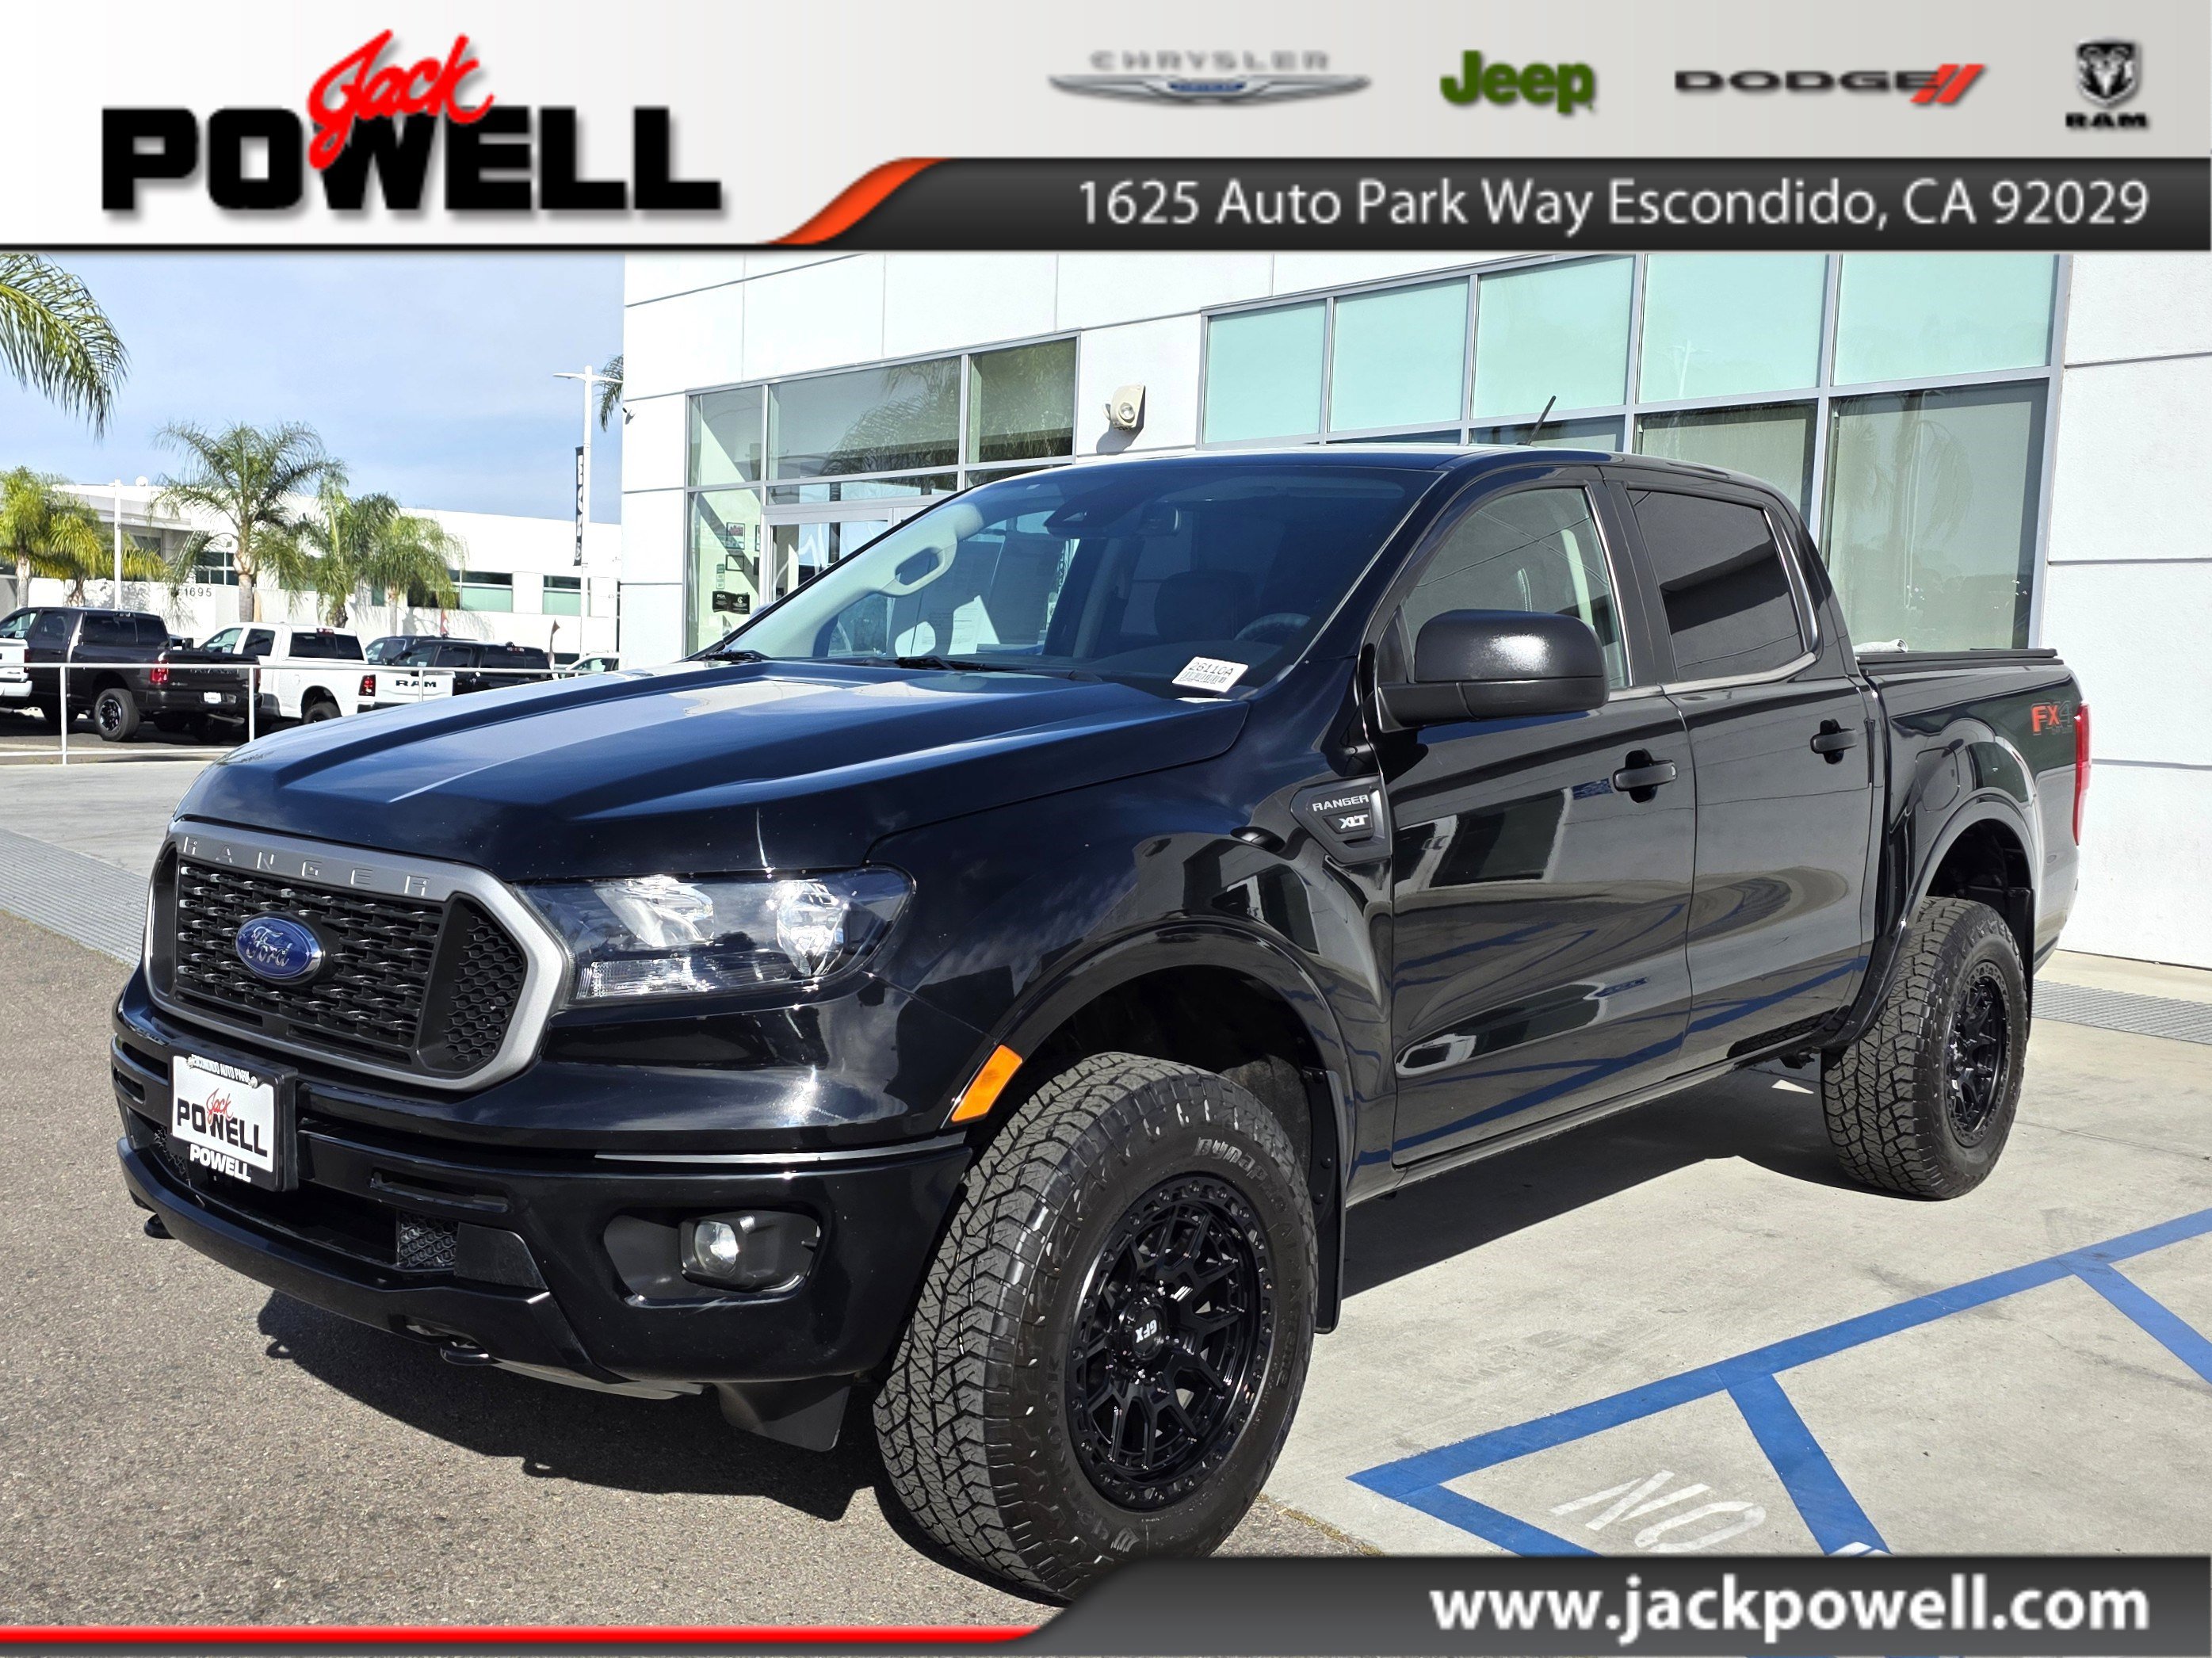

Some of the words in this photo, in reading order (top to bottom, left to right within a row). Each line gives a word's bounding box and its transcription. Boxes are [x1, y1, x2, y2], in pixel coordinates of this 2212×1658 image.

[185, 586, 212, 598] 1695
[395, 679, 437, 688] RAM
[1312, 793, 1370, 812] RANGER
[1338, 813, 1369, 830] XLT
[182, 835, 432, 897] RANGER
[244, 924, 291, 968] Ford
[206, 1087, 234, 1125] Jack
[177, 1097, 268, 1158] POWELL
[189, 1143, 252, 1183] POWELL
[1546, 1469, 1767, 1554] NO
